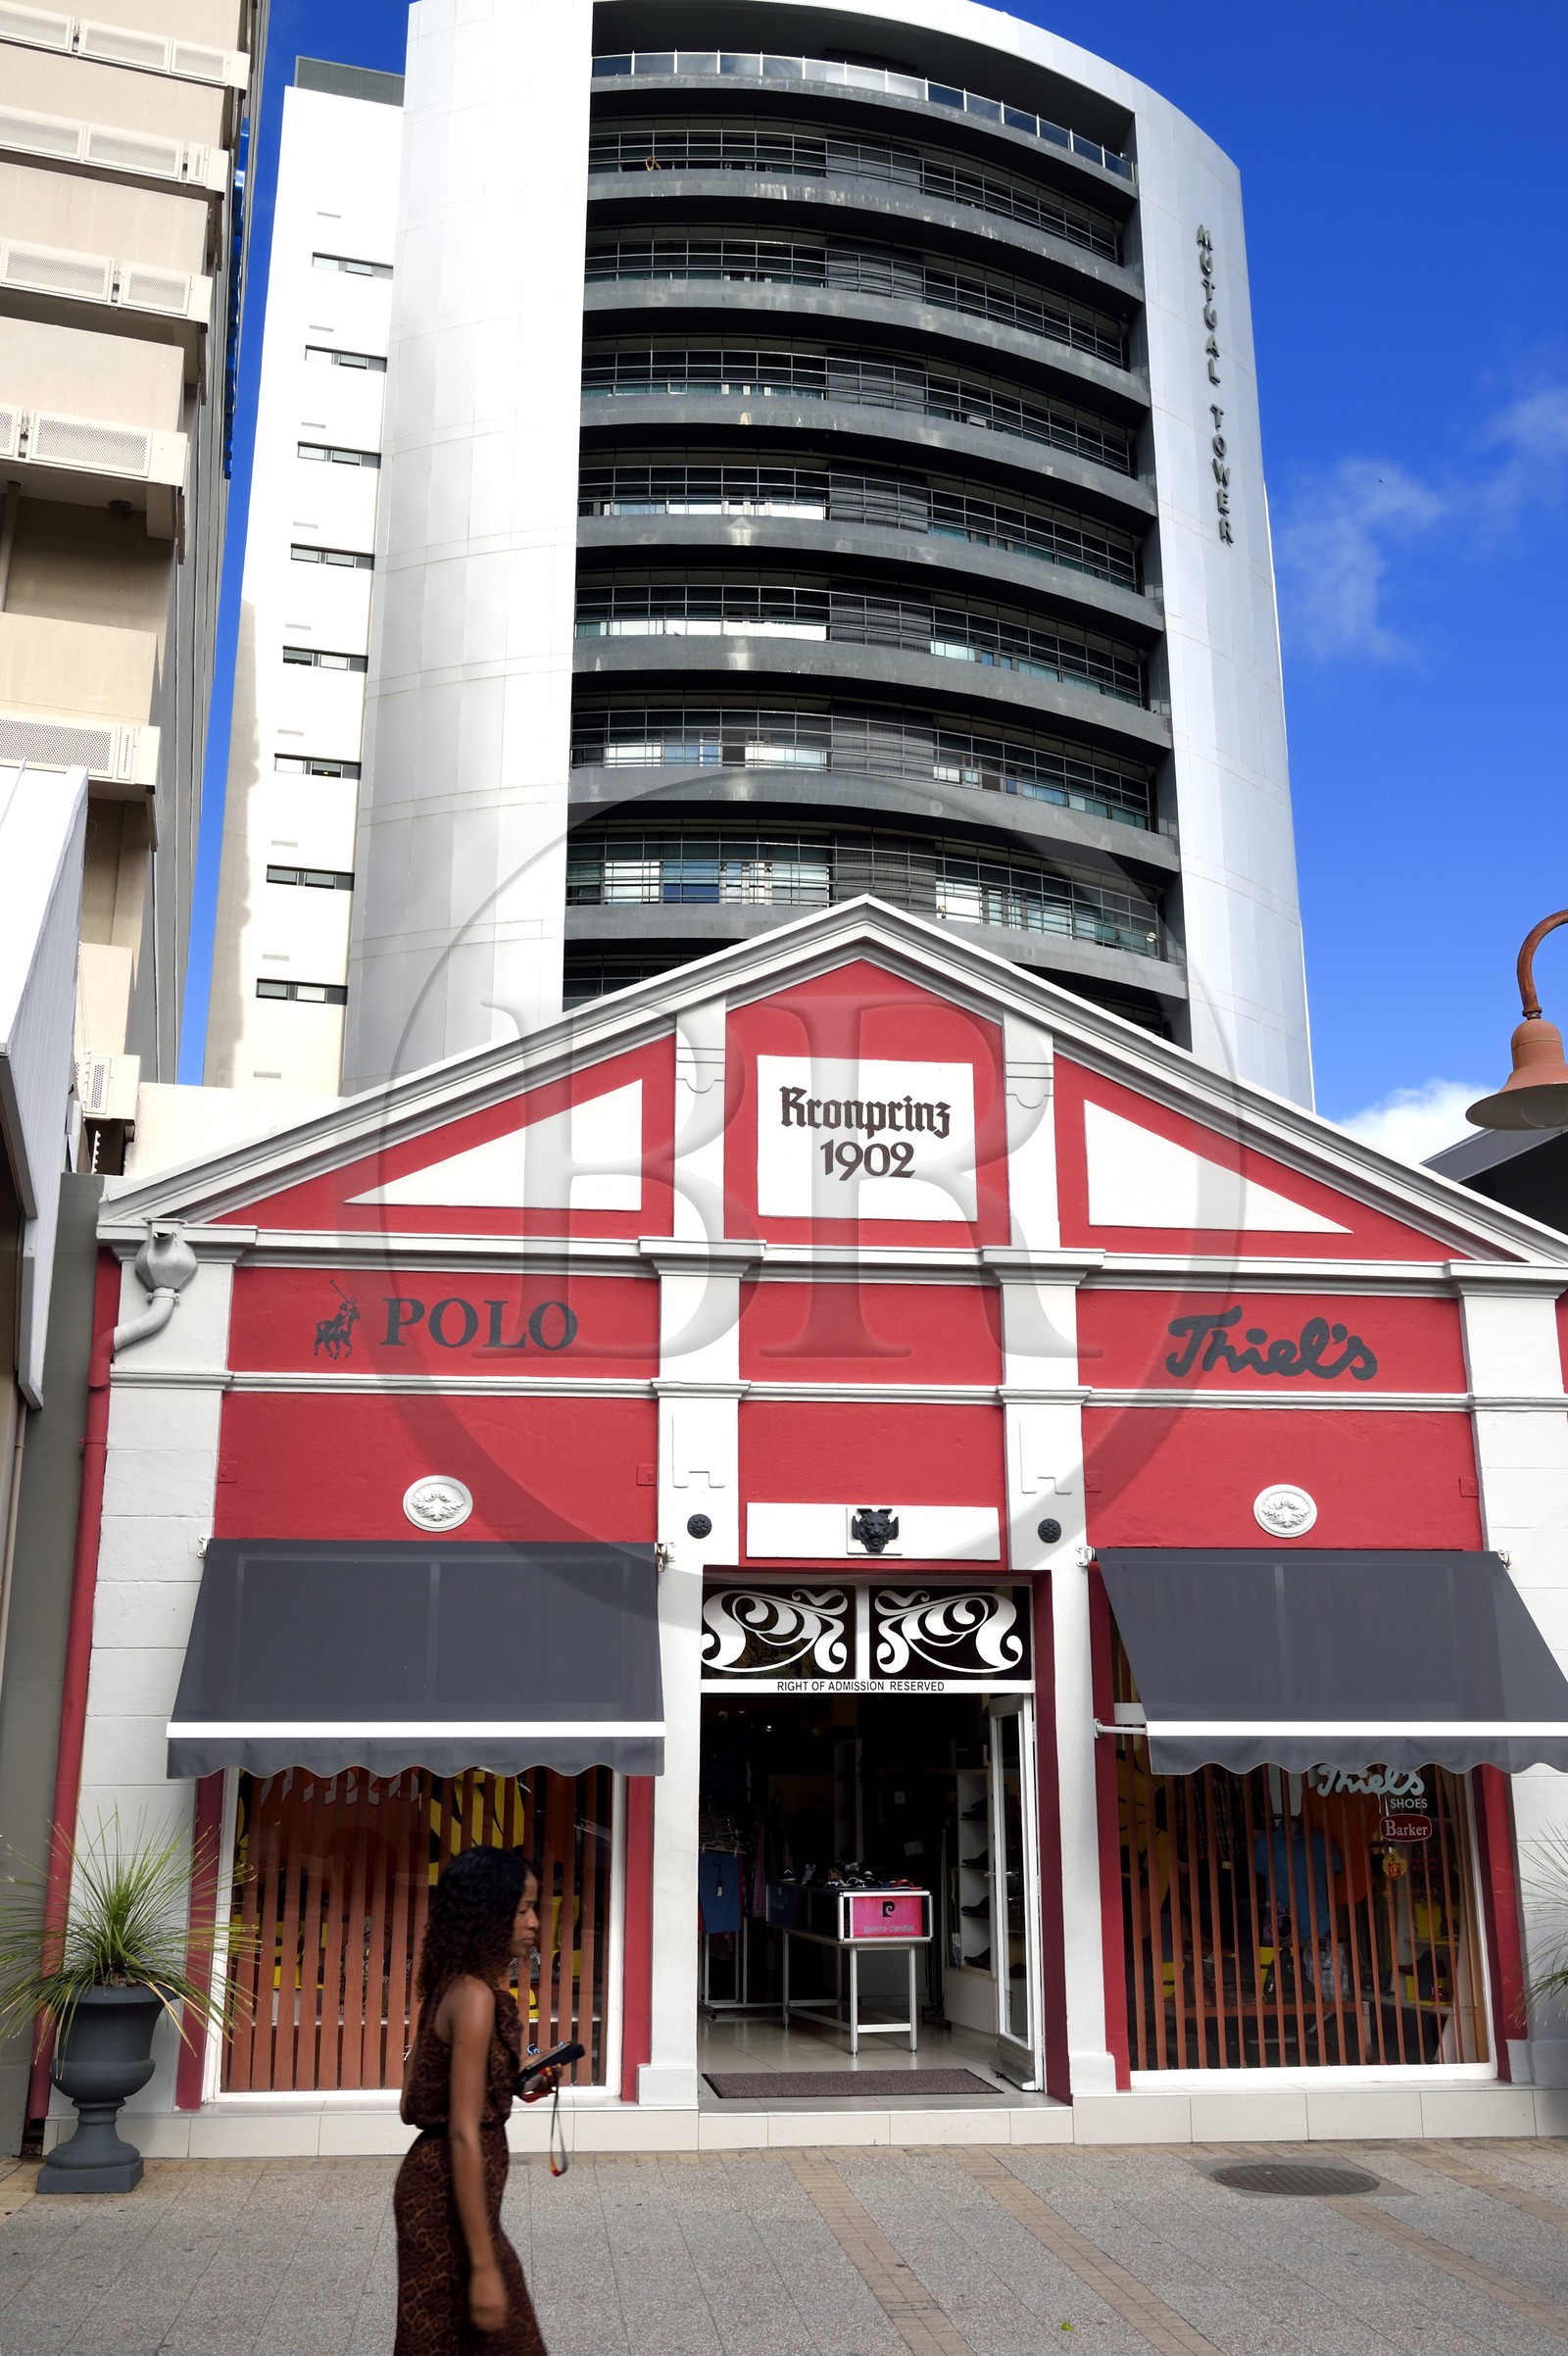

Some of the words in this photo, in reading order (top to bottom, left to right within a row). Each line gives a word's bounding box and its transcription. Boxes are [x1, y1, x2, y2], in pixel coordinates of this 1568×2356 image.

[1197, 224, 1221, 386] MUTUAL
[1210, 403, 1234, 546] TOWER
[779, 1086, 952, 1140] Kronprinz
[820, 1139, 915, 1181] 1902
[379, 1298, 578, 1350] POLO
[1165, 1304, 1378, 1381] Thiel's
[777, 1681, 808, 1692] RIGHT
[811, 1681, 825, 1692] OF
[828, 1681, 884, 1692] ADMISSION
[890, 1681, 945, 1692] RESERVED
[1316, 1764, 1425, 1796] Thiels
[1390, 1797, 1428, 1809] SHOES
[1384, 1819, 1428, 1837] Barker
[863, 1924, 887, 1934] pierre
[889, 1923, 914, 1933] cardin
